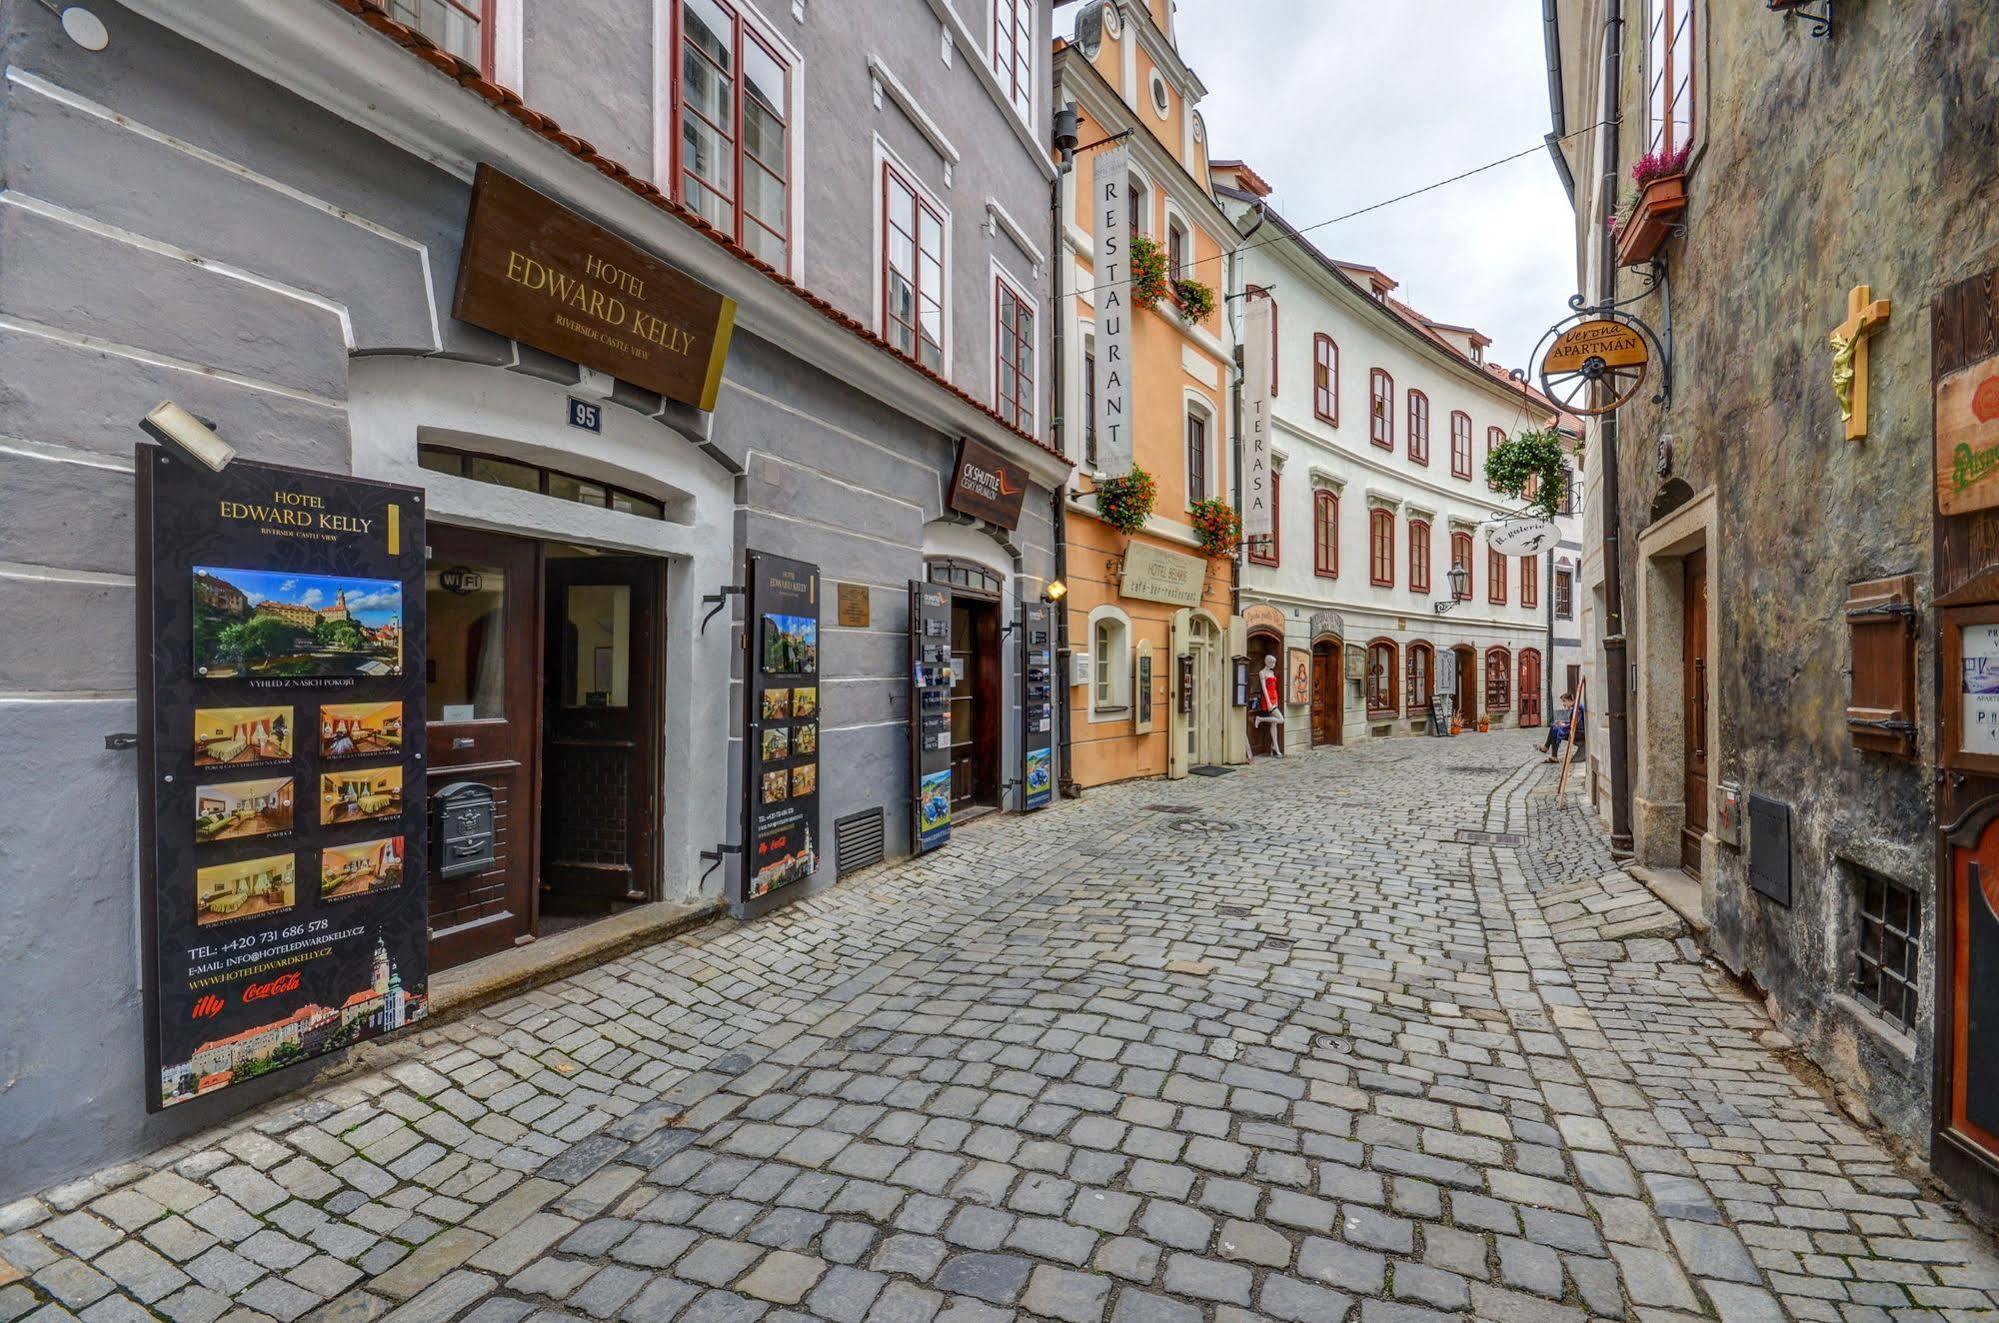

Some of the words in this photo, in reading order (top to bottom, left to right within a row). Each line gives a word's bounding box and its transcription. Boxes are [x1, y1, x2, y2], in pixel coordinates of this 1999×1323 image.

[585, 254, 648, 301] HOTEL
[505, 251, 626, 326] EDWARD
[632, 310, 697, 357] KELLY
[1105, 183, 1122, 442] RESTAURANT
[555, 315, 600, 340] RIVERSIDE
[600, 335, 630, 352] CASTLE
[631, 346, 649, 360] VIEW
[1553, 338, 1636, 358] APARTMÁN
[1566, 325, 1622, 343] Verona
[575, 403, 596, 427] 95
[1253, 400, 1263, 510] TERASA
[963, 463, 975, 478] CK
[973, 467, 1000, 491] SHUTTLE
[220, 501, 313, 527] EDWARD
[319, 514, 372, 534] KELLY
[275, 491, 325, 510] HOTEL
[261, 528, 295, 537] RIVERSIDE
[188, 946, 218, 960] TEL:
[221, 936, 256, 953] +420
[260, 931, 278, 944] 731
[282, 924, 304, 938] 686
[308, 918, 329, 933] 578
[188, 961, 224, 976] E-MAIL:
[226, 925, 365, 967] INFO@HOTELEDWARDKELLY.CZ
[188, 947, 333, 991] WWW.HOTELEDWARDKELLY.CZ
[192, 993, 225, 1020] illy
